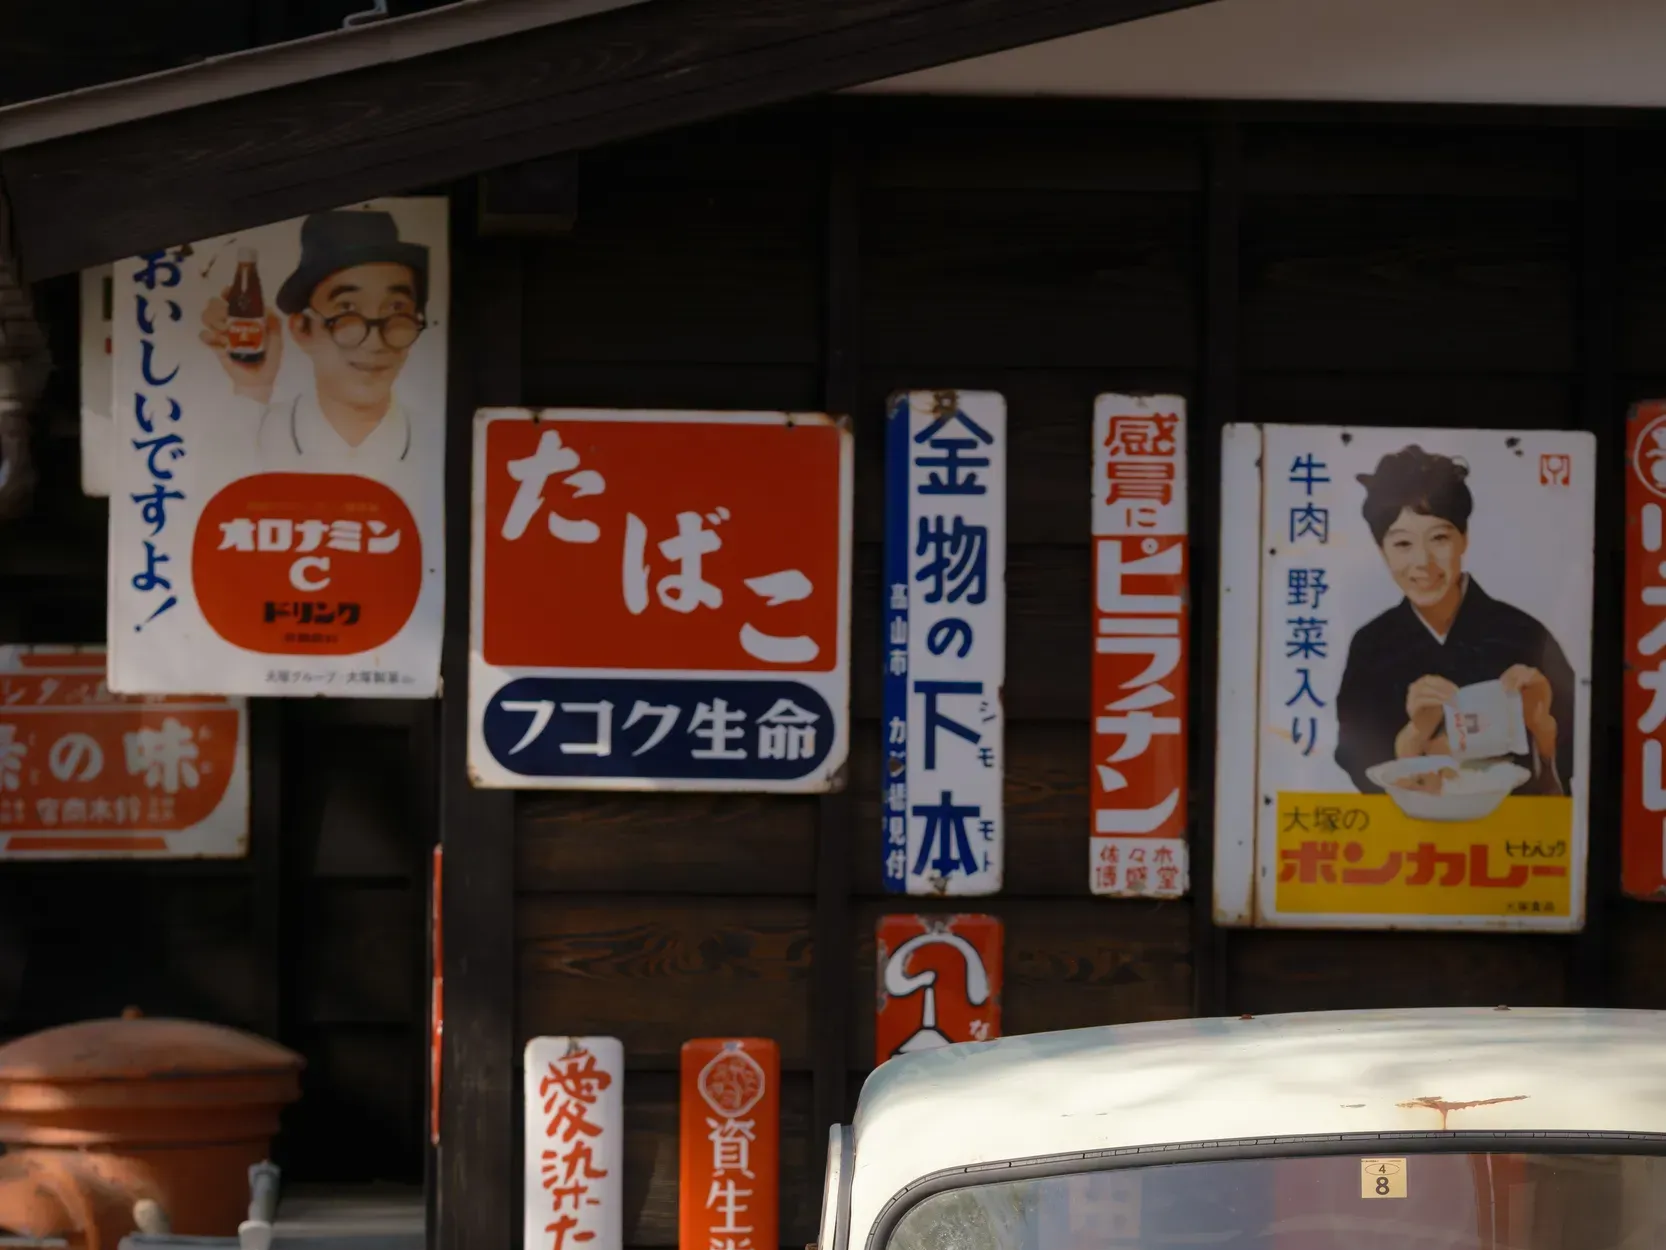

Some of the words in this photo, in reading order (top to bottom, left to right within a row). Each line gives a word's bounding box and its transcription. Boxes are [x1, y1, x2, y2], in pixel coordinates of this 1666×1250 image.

[1104, 412, 1179, 528] 感冒に
[1289, 453, 1331, 544] 牛肉
[217, 518, 401, 554] オロナミン
[502, 429, 820, 664] たばこ
[289, 556, 331, 592] C
[264, 601, 361, 625] ドリンク
[911, 407, 995, 877] 金物の下本
[1285, 568, 1329, 756] 野菜入り
[1095, 539, 1183, 834] ピラチン
[500, 697, 821, 762] フコク生命
[1282, 806, 1370, 833] 大塚の
[1278, 841, 1567, 888] ボンカレー
[1375, 1176, 1390, 1195] 8
[1378, 1164, 1386, 1174] 4
